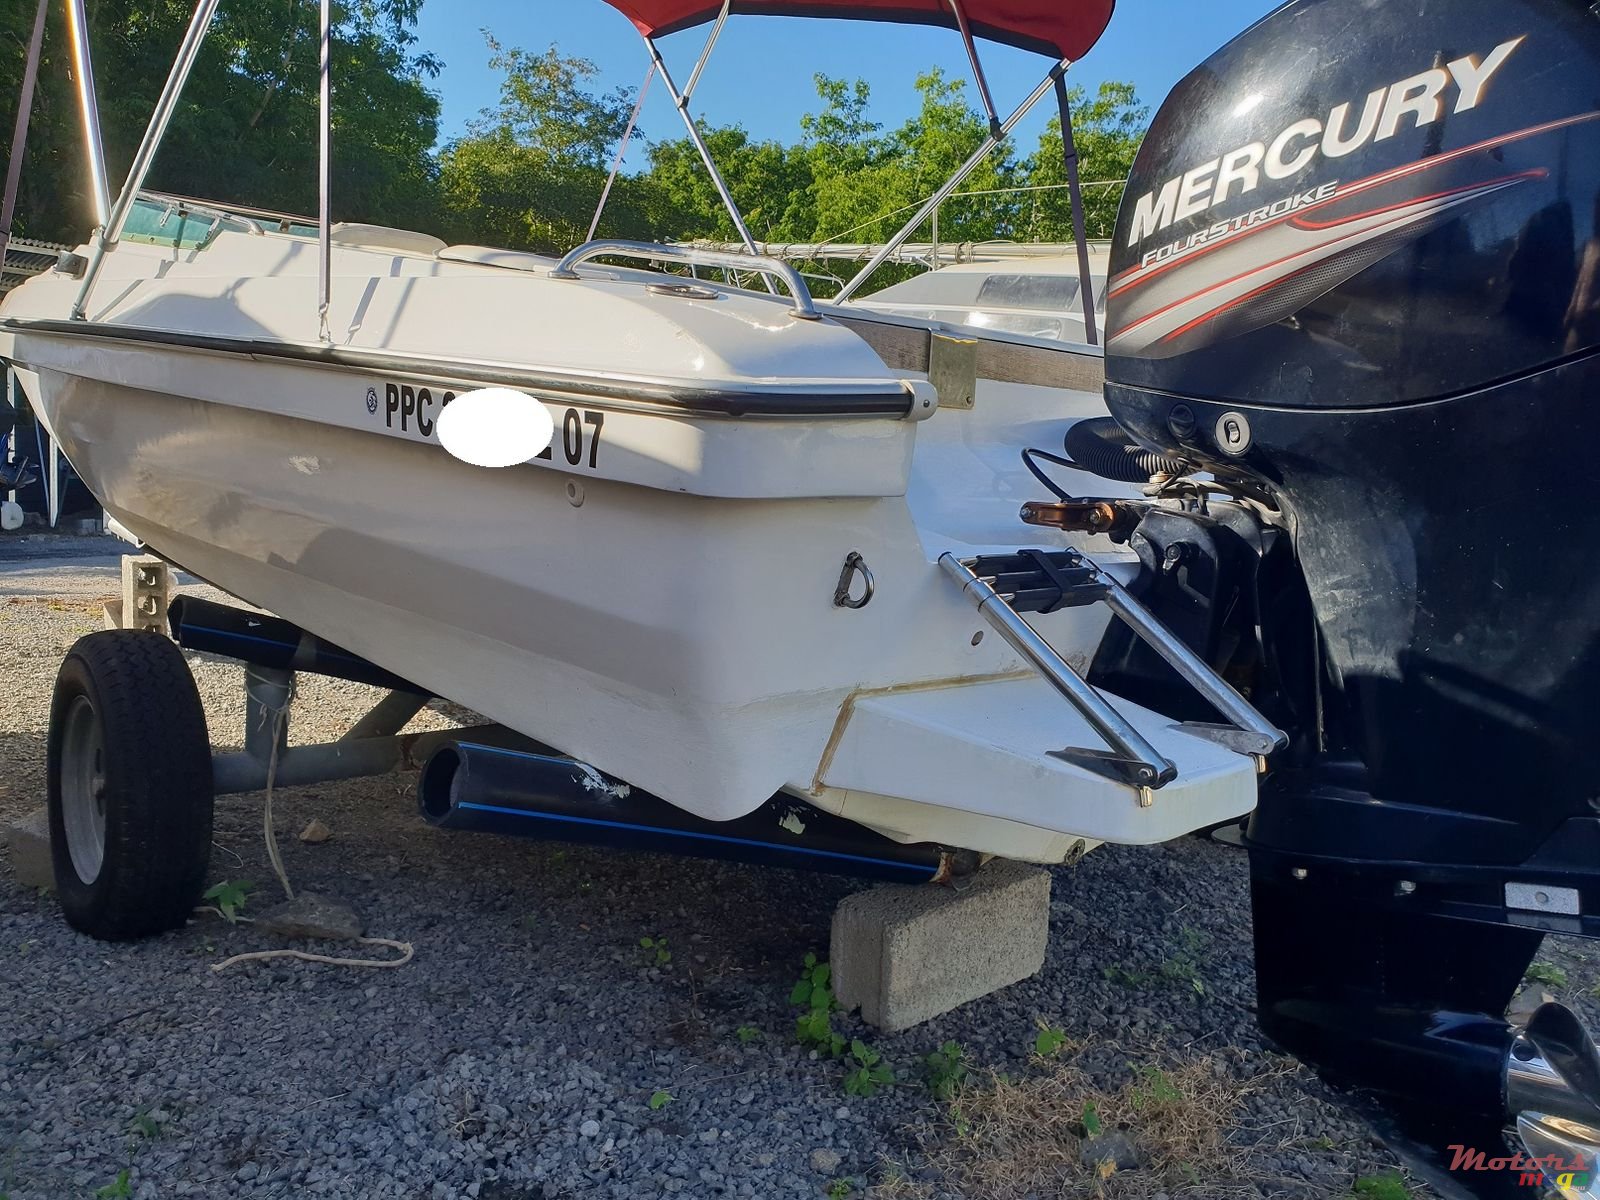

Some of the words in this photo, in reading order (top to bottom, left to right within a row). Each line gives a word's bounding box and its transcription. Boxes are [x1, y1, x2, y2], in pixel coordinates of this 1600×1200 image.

[1127, 34, 1529, 247] MERCURY
[1140, 178, 1339, 269] FOURSTROKE
[385, 382, 434, 437] PPC
[562, 407, 604, 469] 07
